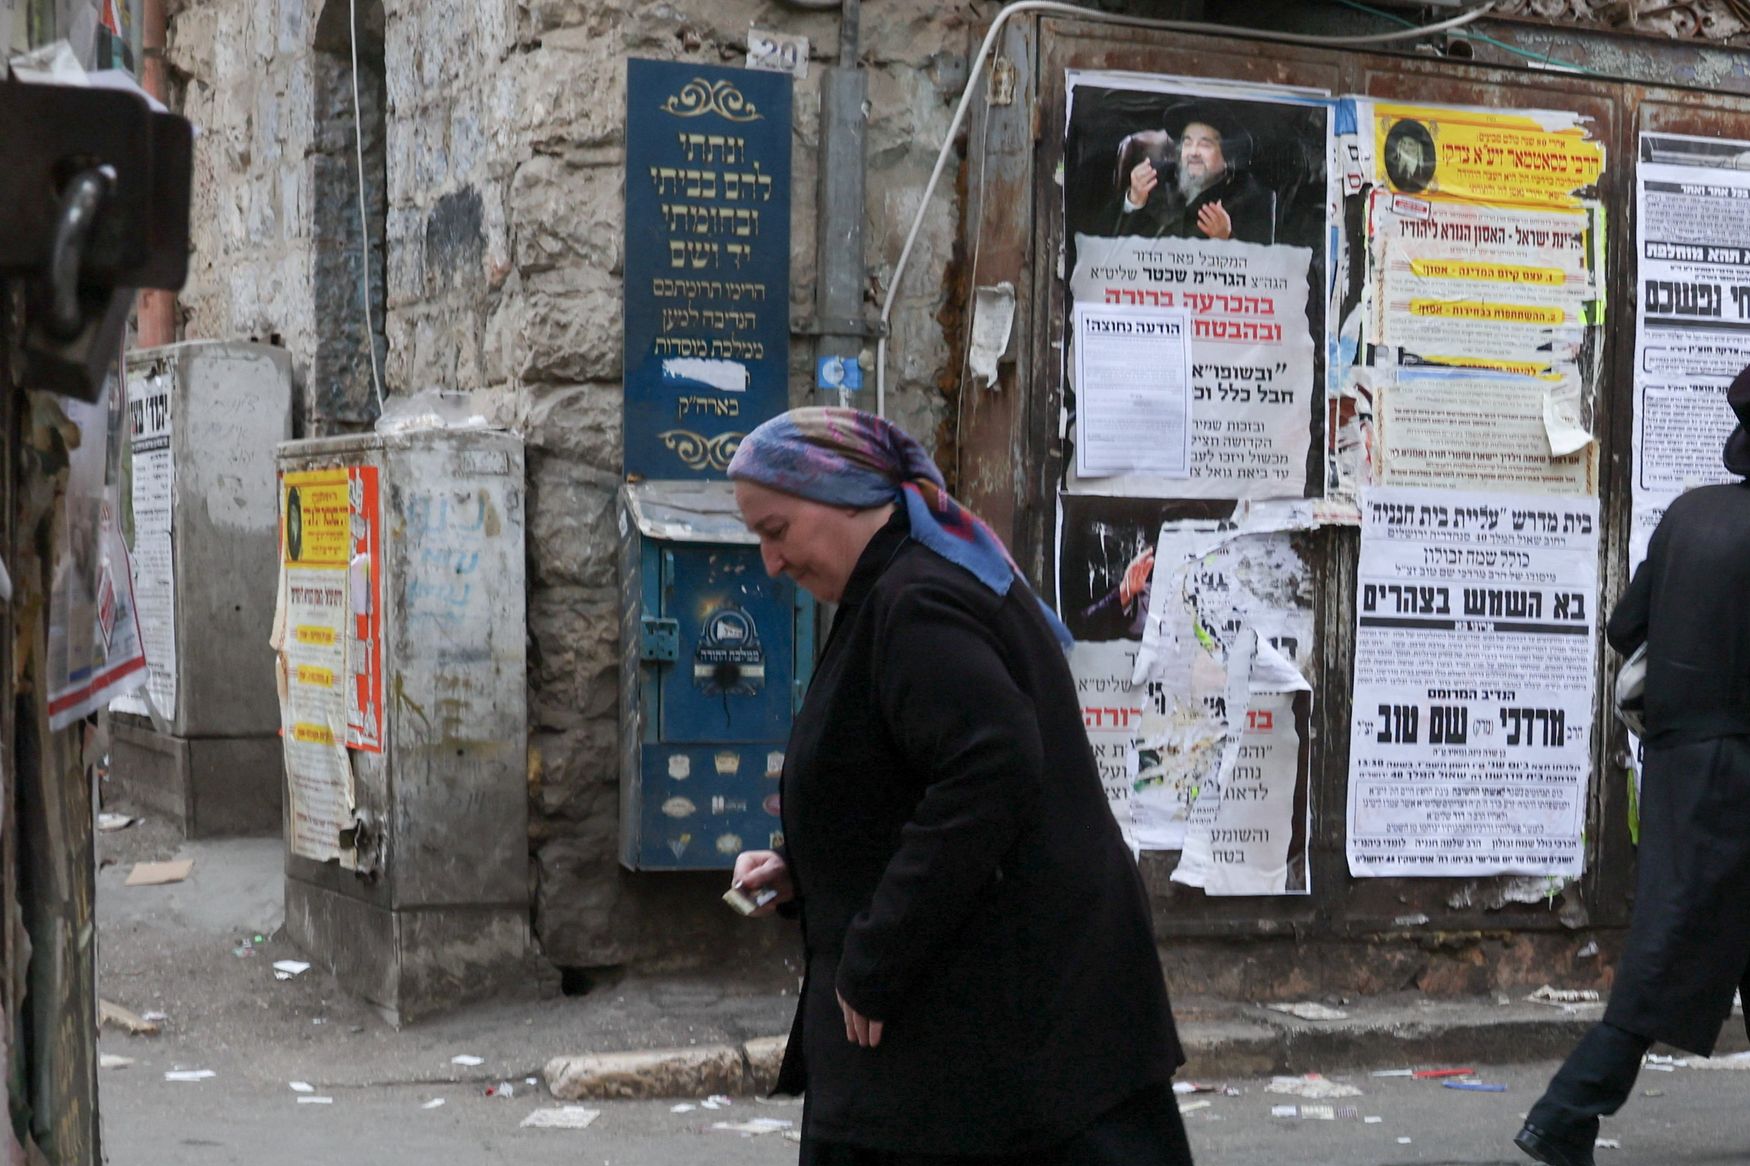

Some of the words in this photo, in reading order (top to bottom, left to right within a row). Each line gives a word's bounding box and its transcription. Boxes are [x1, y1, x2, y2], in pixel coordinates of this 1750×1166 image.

[758, 39, 798, 71] 20
[678, 132, 745, 163] ונתתי
[650, 167, 716, 198] בביתי
[723, 161, 772, 202] להם
[661, 204, 759, 236] ובחומתי
[669, 240, 719, 269] ושם
[726, 243, 751, 270] יד
[1645, 279, 1722, 318] נפשכם
[1190, 318, 1283, 342] ובהבטח
[1193, 384, 1212, 402] וכ
[1418, 504, 1449, 528] בית
[1511, 509, 1558, 534] מדרש
[1563, 512, 1593, 535] בית
[1363, 583, 1451, 614] בצהרים
[1463, 587, 1543, 619] השמש
[1553, 592, 1586, 621] בא
[1376, 703, 1419, 745] טוב
[1428, 705, 1468, 745] שם
[1499, 707, 1565, 747] מרדכי
